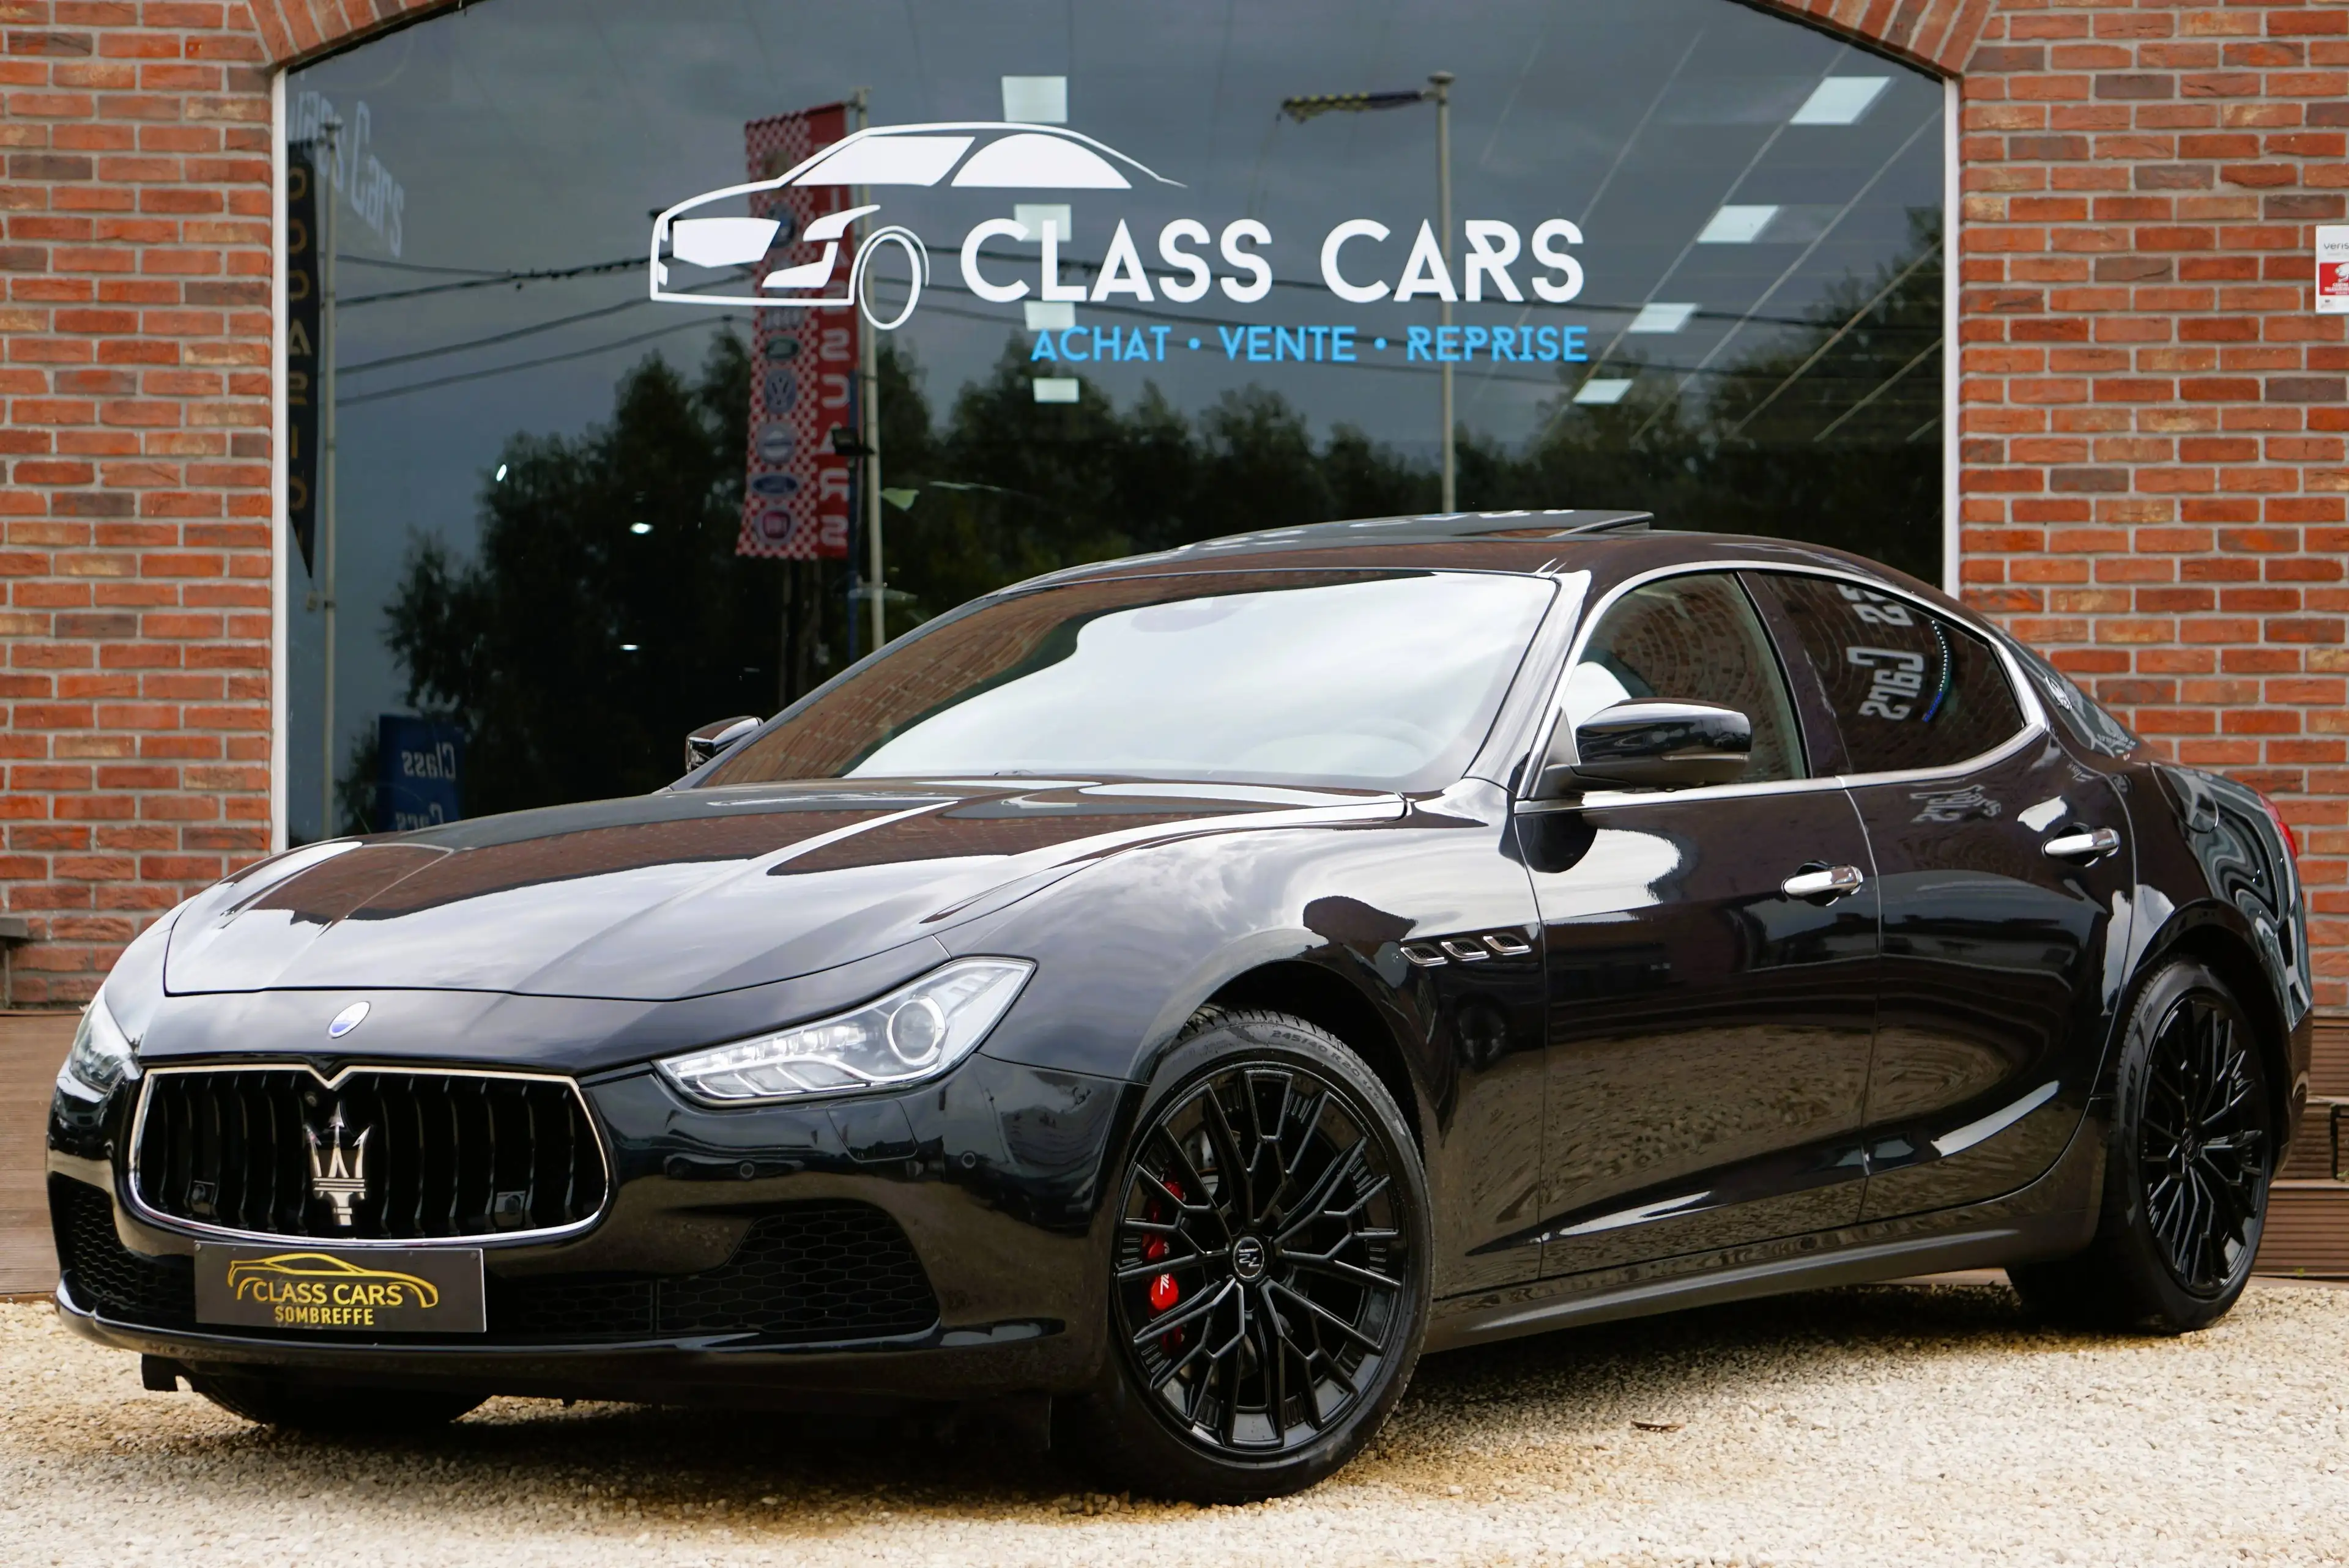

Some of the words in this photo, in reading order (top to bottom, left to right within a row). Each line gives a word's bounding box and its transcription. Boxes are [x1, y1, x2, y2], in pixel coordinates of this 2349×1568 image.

[961, 218, 1272, 303] CLASS
[1321, 218, 1584, 303] CARS
[1030, 325, 1172, 363] ACHAT
[1218, 325, 1358, 363] VENTE
[1406, 325, 1589, 363] REPRISE
[253, 1281, 328, 1304] CLASS
[332, 1283, 403, 1306] CARS
[275, 1306, 374, 1326] SOMBREFFE
